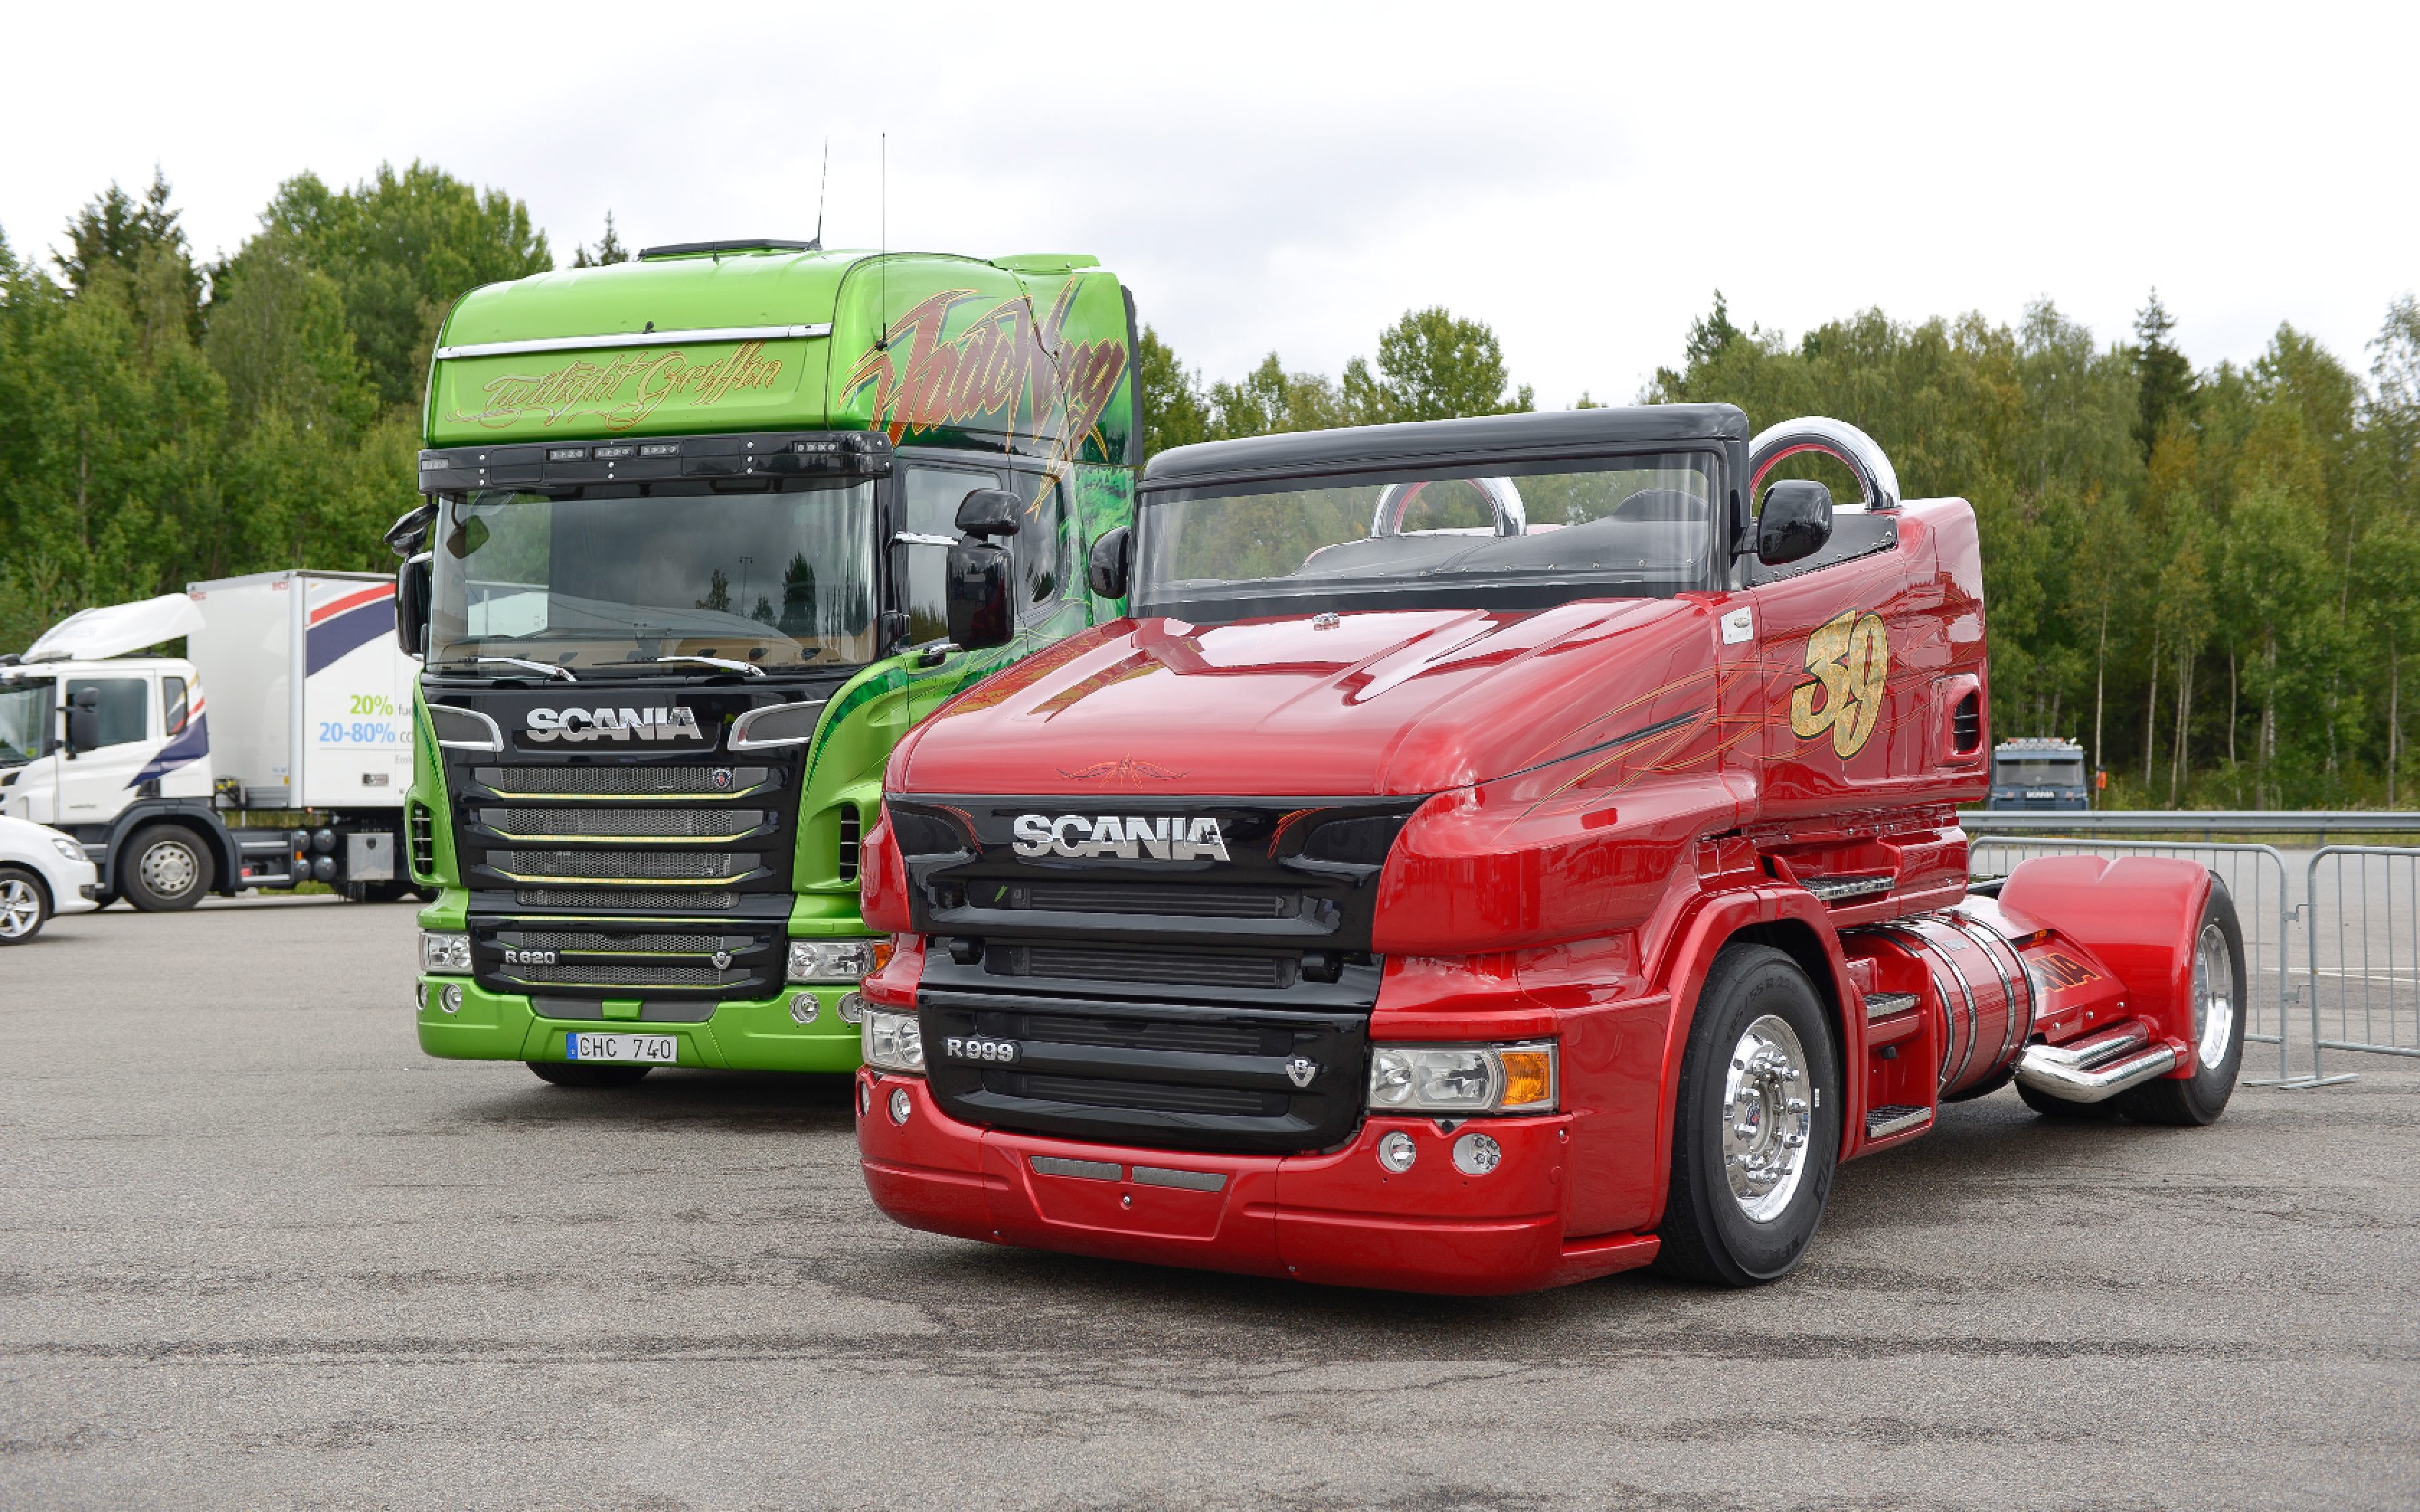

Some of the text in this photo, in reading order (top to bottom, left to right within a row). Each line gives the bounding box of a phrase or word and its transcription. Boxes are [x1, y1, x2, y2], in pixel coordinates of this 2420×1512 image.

[349, 694, 394, 716] 20%
[319, 722, 395, 743] 20-80%
[526, 707, 703, 742] SCANIA
[1012, 814, 1230, 862] SCANIA
[505, 950, 555, 963] R 620
[633, 1039, 671, 1059] 740
[947, 1038, 1013, 1062] R 999
